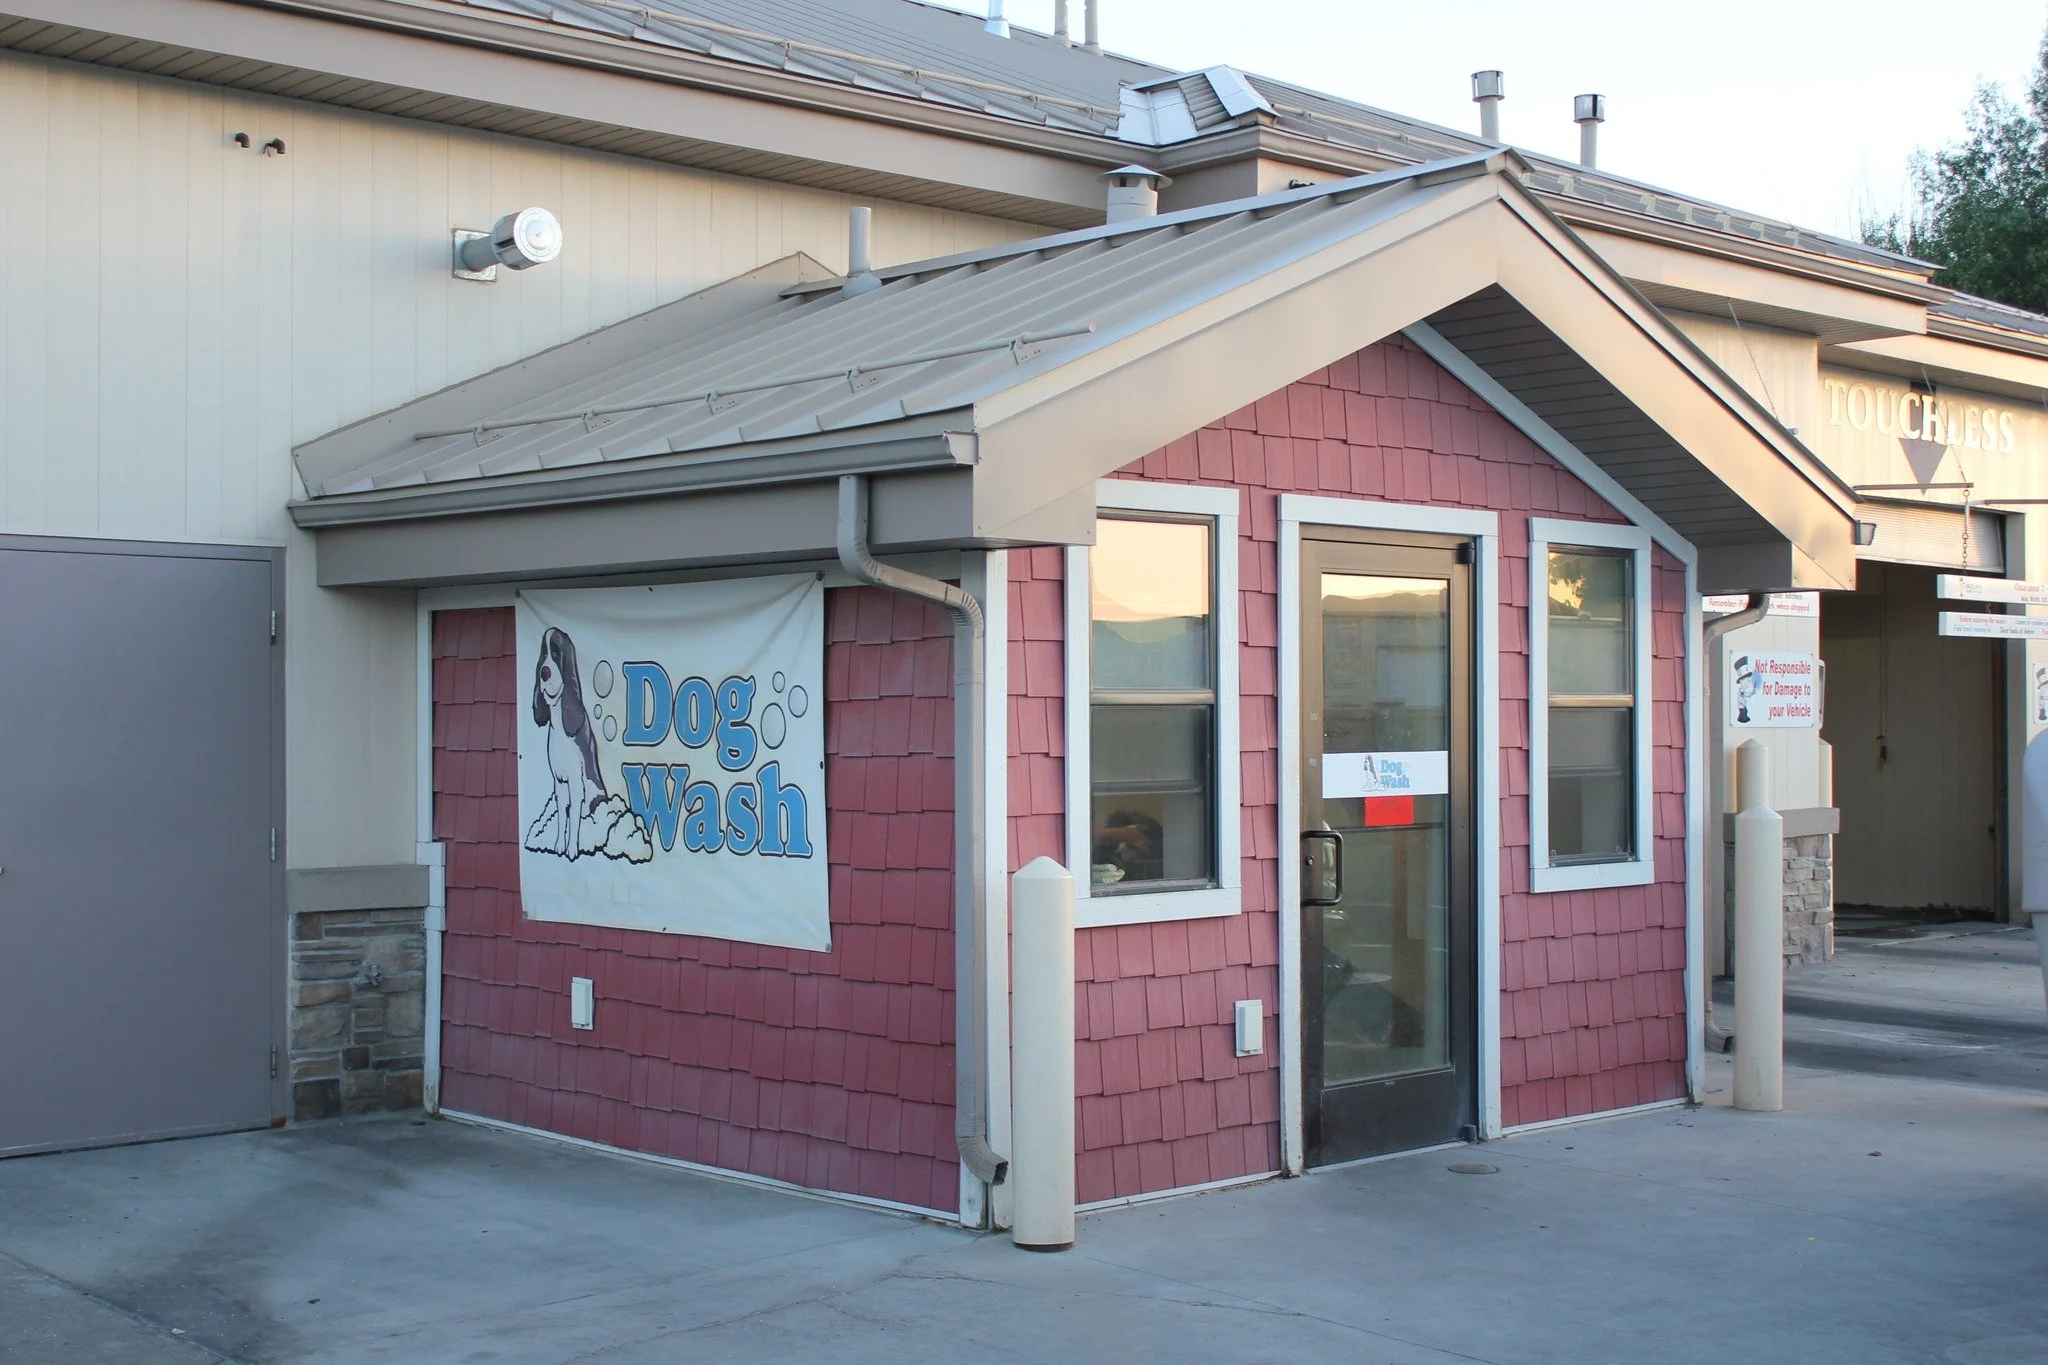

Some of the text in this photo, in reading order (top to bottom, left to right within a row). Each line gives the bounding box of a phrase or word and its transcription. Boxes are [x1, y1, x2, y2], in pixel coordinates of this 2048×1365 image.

[1823, 377, 2014, 454] TOUCHLESS
[1755, 659, 1811, 678] Not Responsible
[1762, 681, 1811, 699] for Damage to
[621, 660, 758, 772] Dog
[1769, 703, 1811, 721] your Vehicle
[1380, 759, 1402, 776] Dog
[1380, 774, 1410, 789] Wash
[621, 761, 813, 859] Wash
